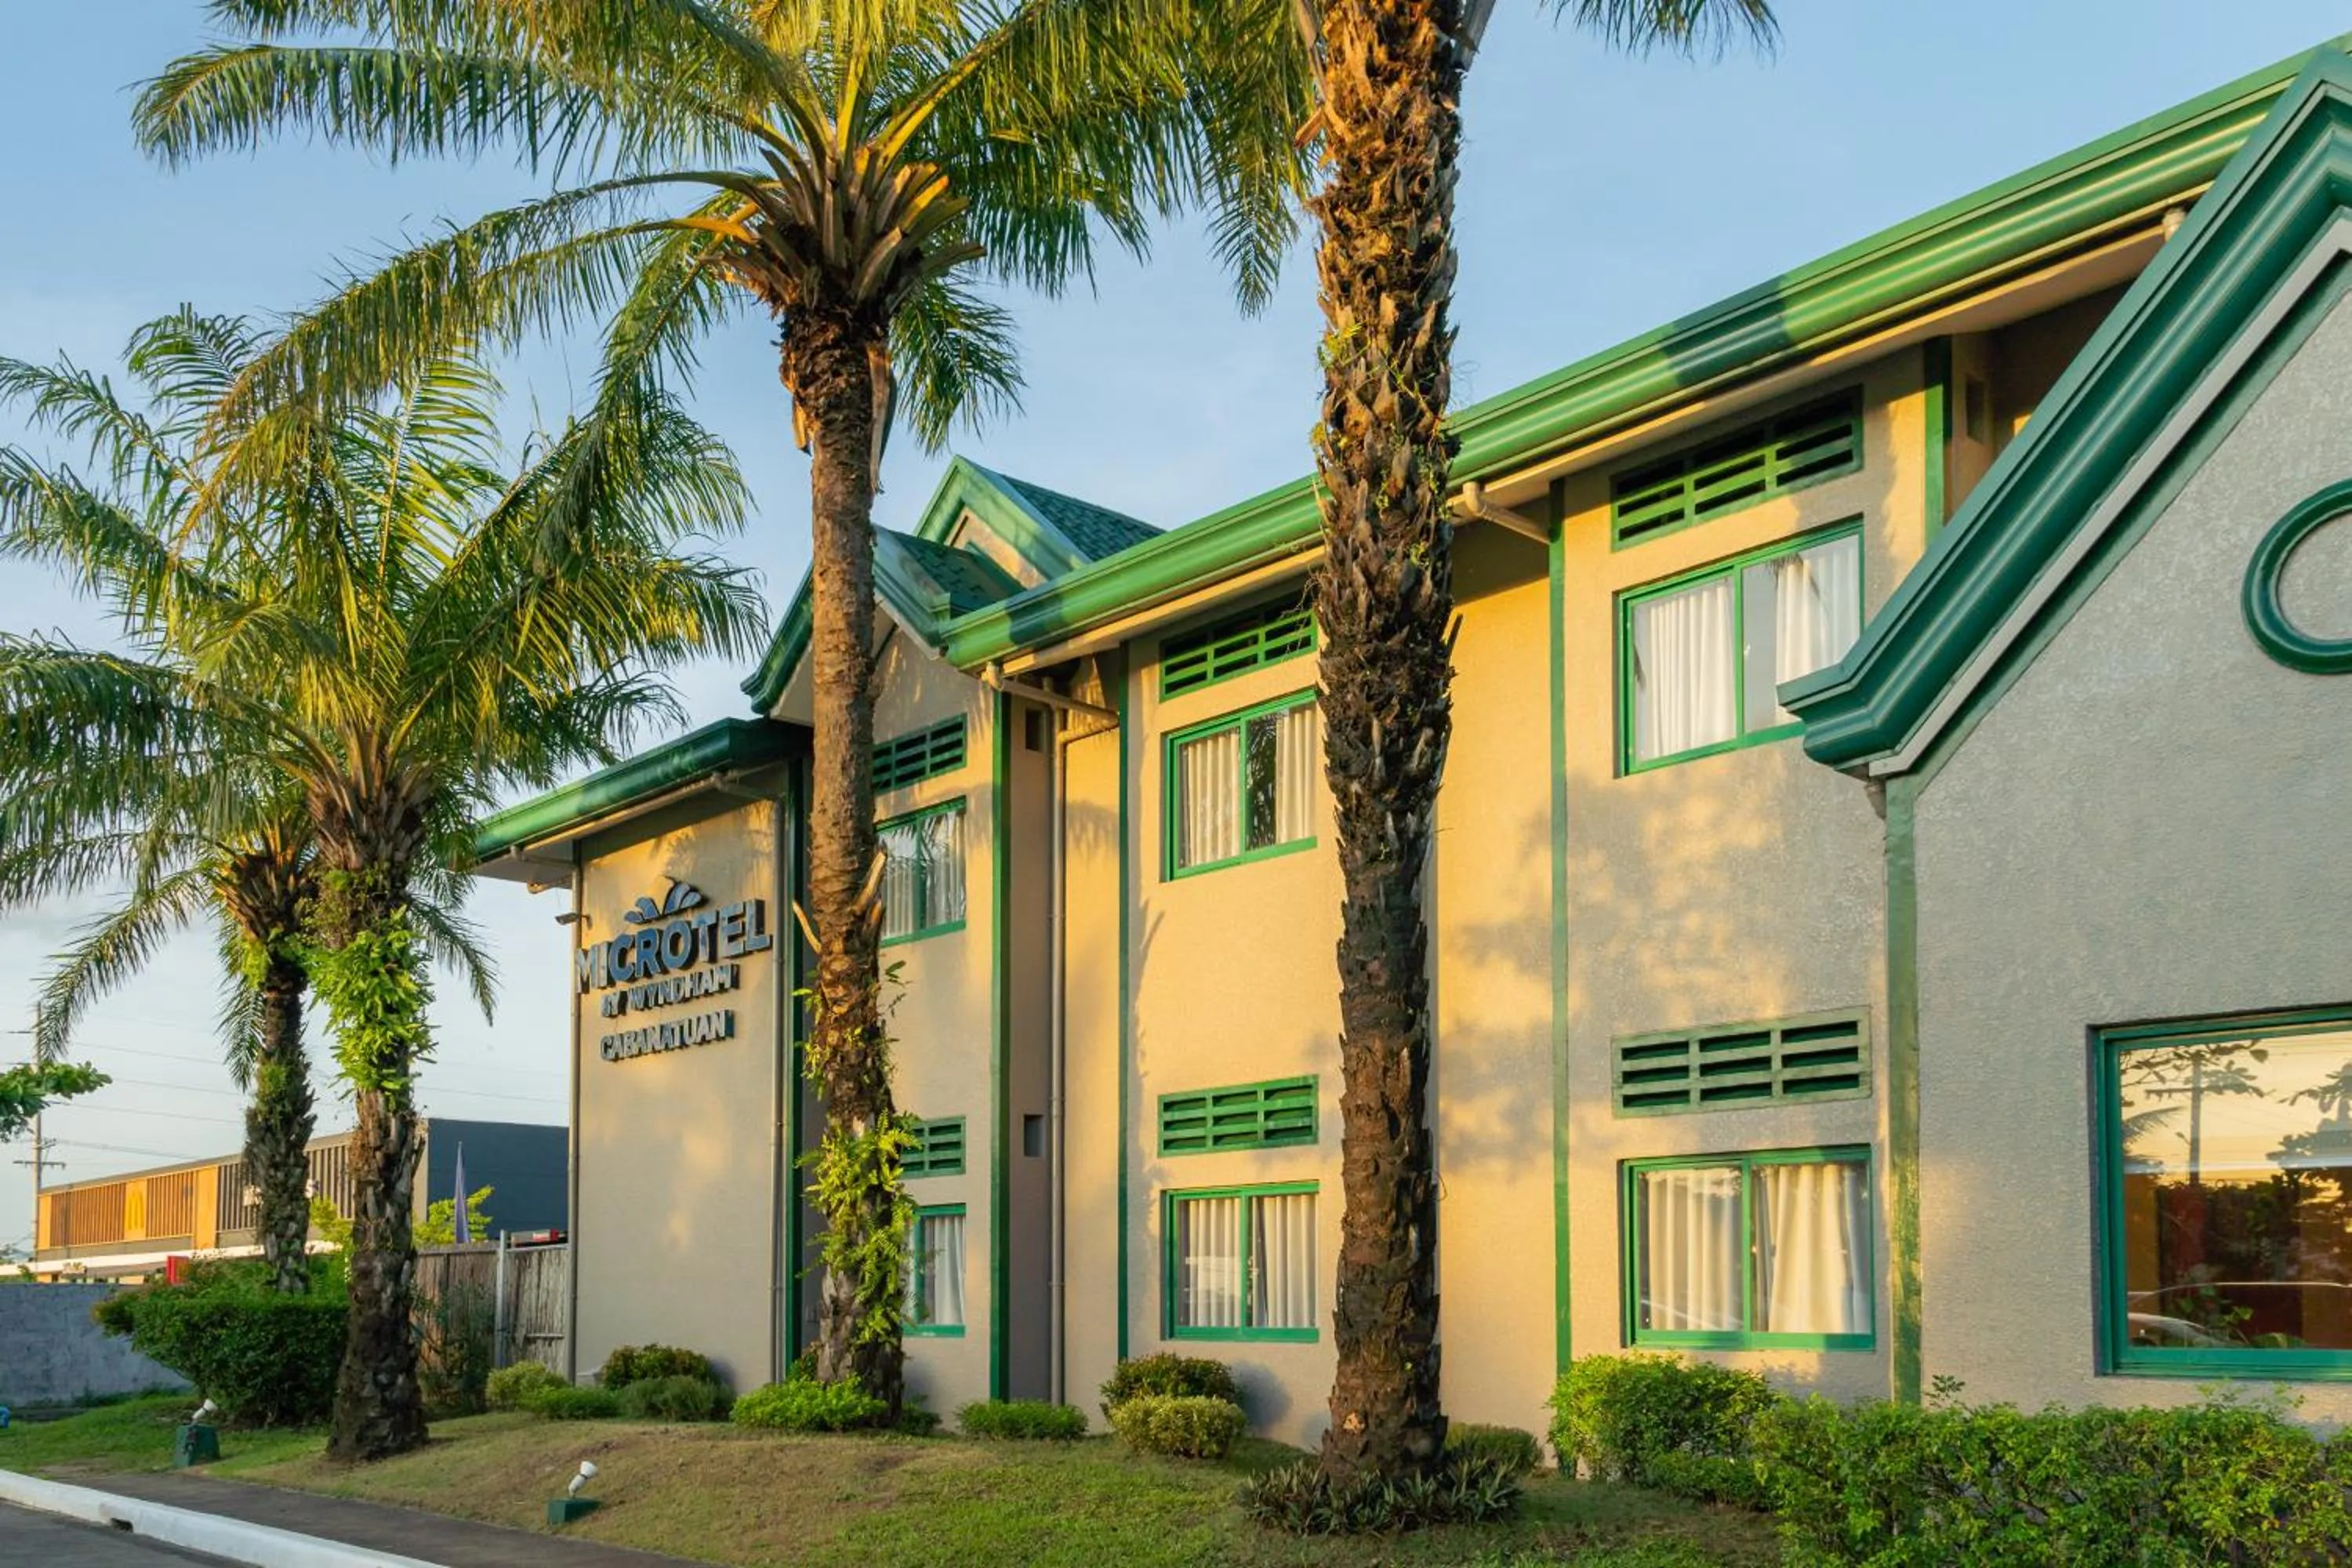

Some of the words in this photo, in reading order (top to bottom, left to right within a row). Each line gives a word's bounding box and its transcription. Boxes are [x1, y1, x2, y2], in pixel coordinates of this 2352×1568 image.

[574, 899, 771, 993] MICROTEL
[601, 992, 623, 1017] BY
[628, 964, 735, 1010] WYNDHAM
[600, 1009, 730, 1061] CABANATUAN
